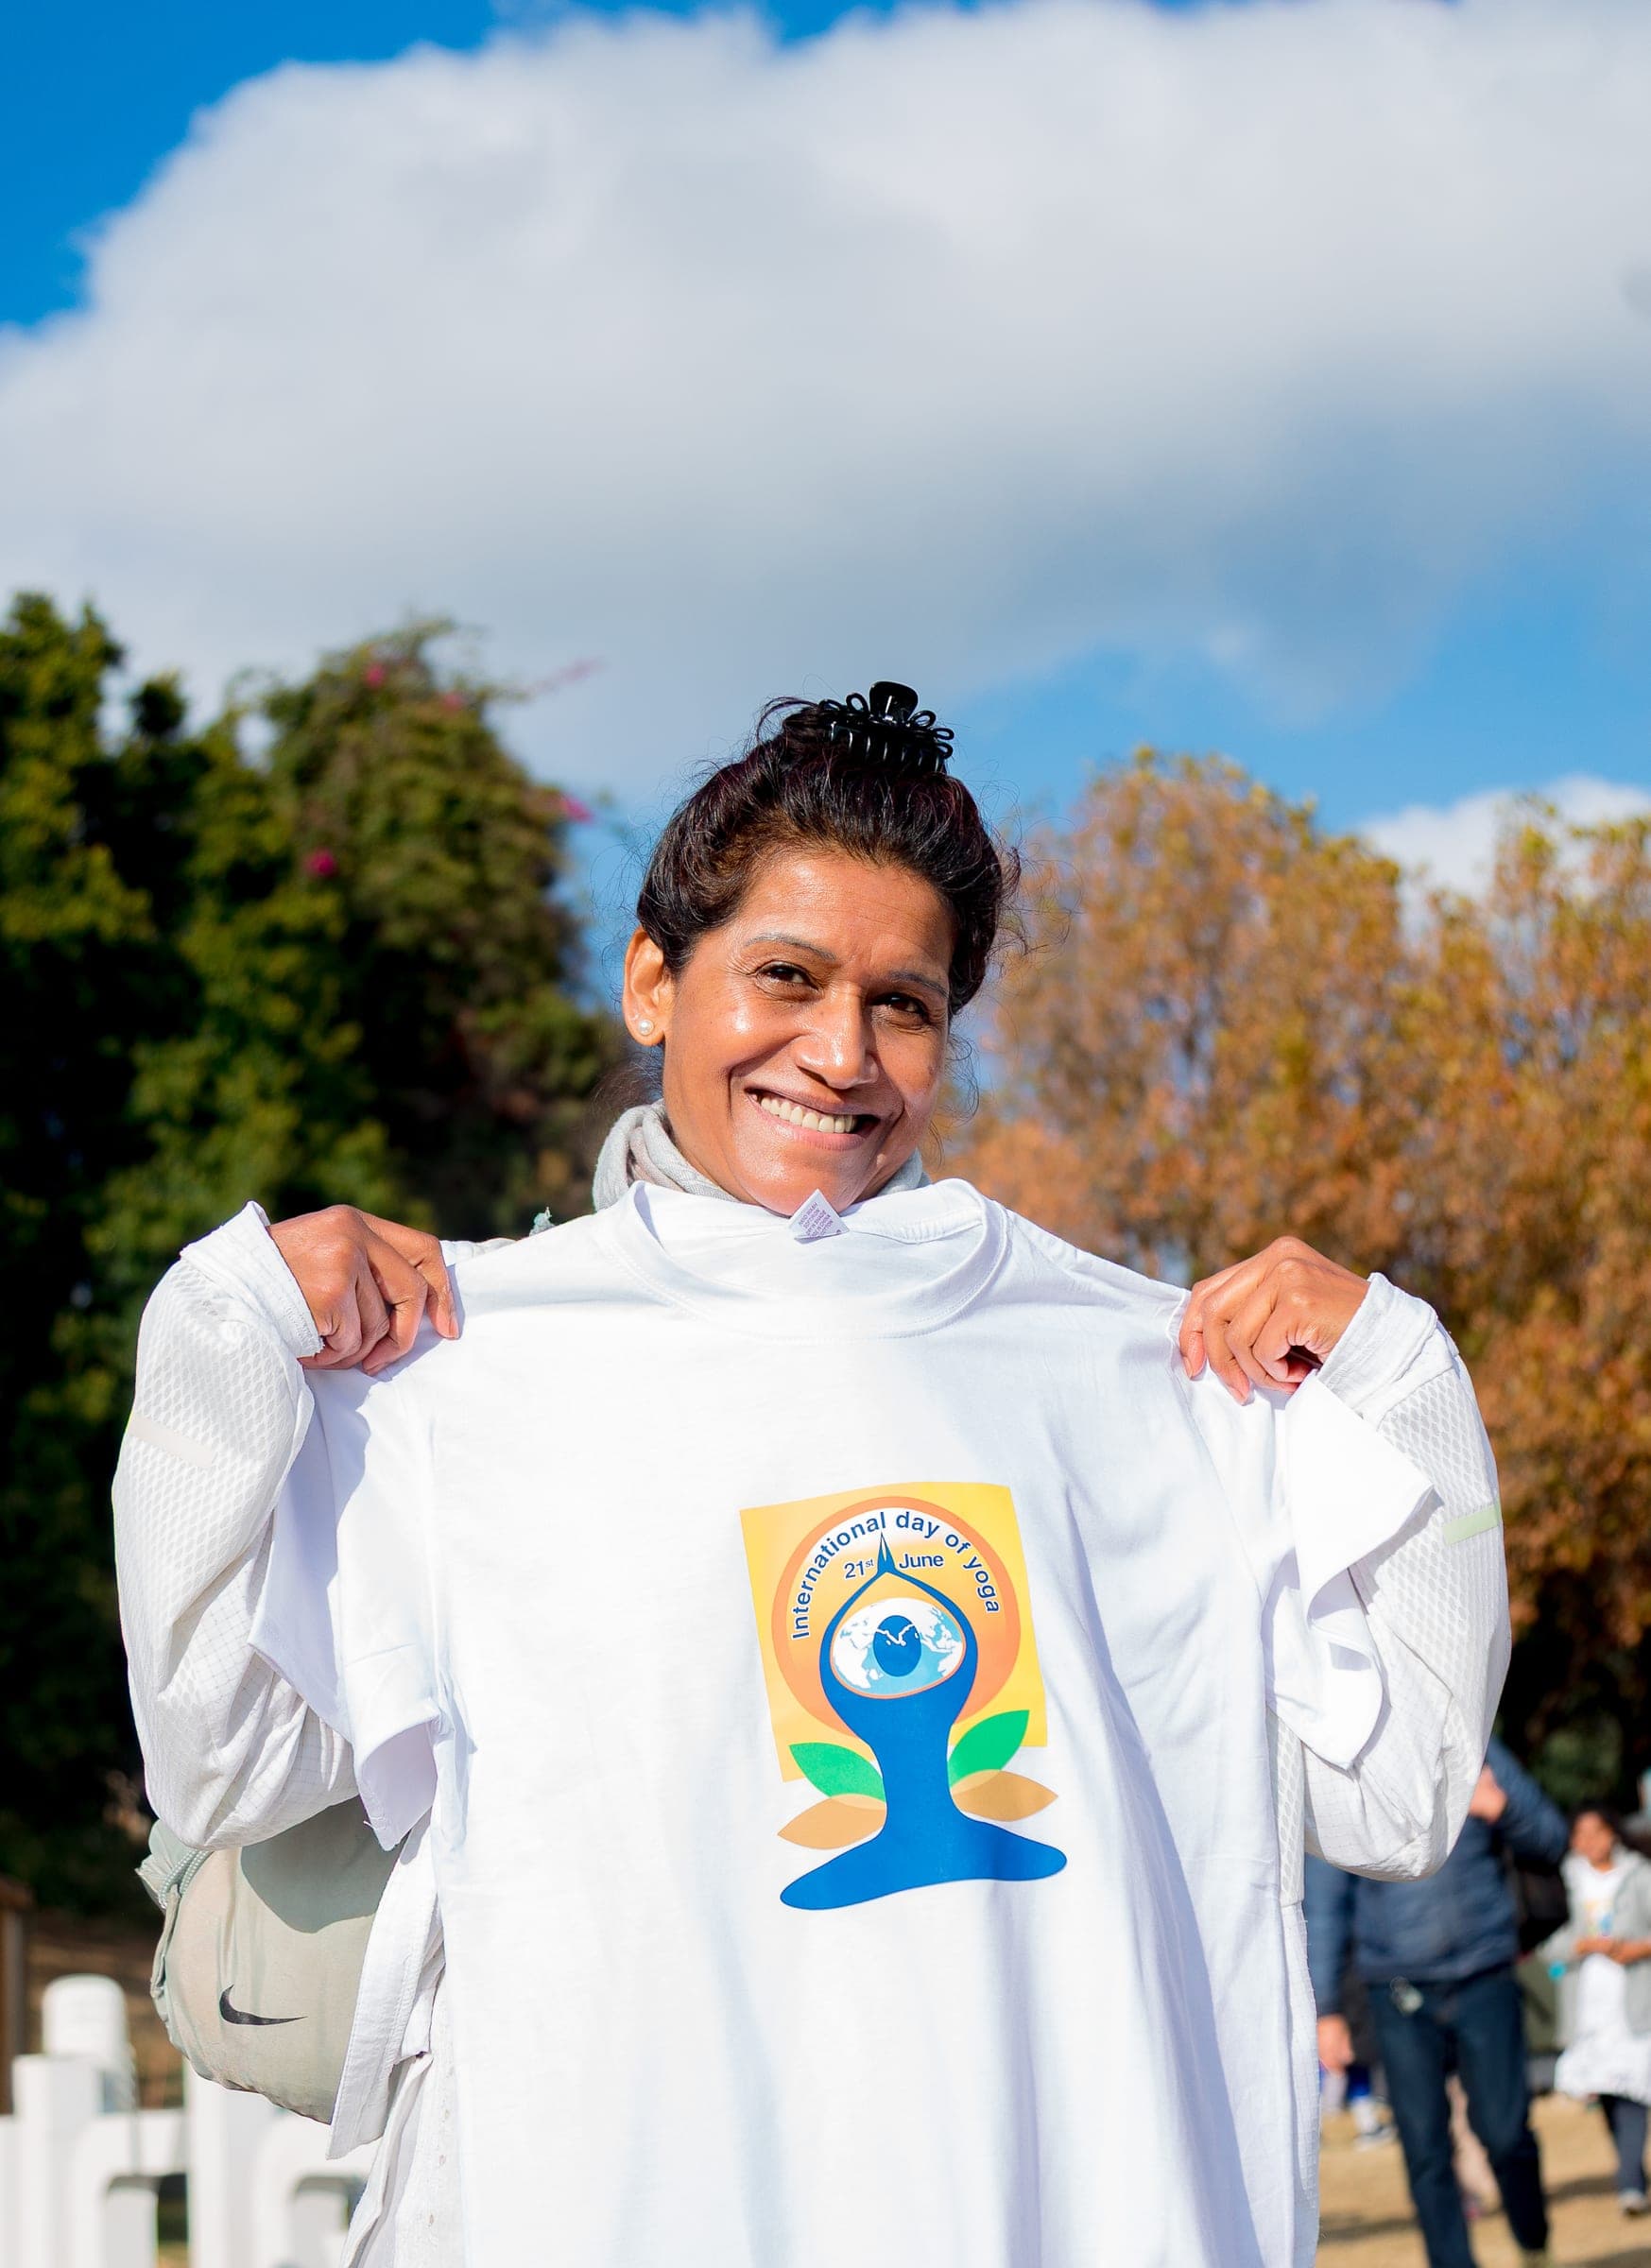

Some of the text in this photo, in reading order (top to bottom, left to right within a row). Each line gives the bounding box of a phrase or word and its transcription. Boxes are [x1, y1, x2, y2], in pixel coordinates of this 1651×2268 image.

[792, 1511, 1000, 1640] International day of yoga
[844, 1554, 944, 1579] 21st June
